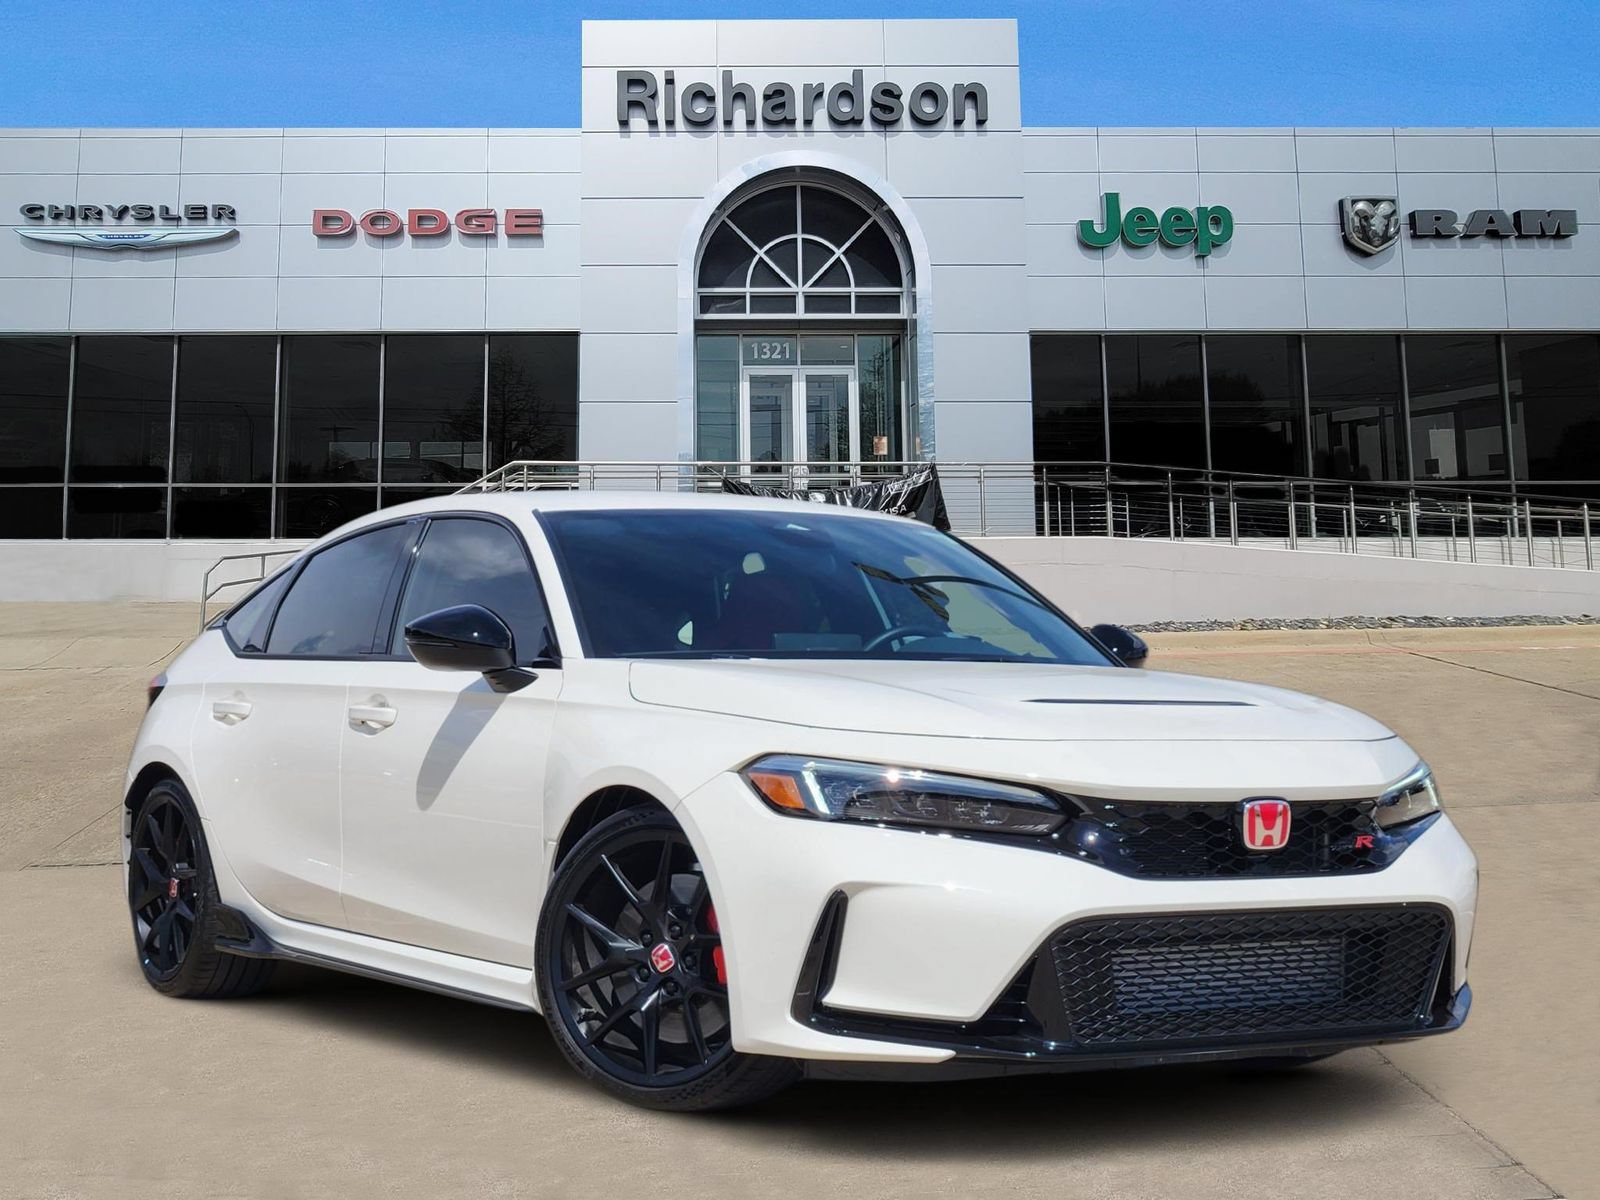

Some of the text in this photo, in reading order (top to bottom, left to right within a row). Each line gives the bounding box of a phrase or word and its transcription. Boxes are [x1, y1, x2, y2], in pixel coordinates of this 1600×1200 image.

[616, 69, 989, 127] Richardson
[19, 203, 237, 220] CHRYSLER
[312, 208, 545, 238] DODGE
[1077, 192, 1234, 257] Jeep
[1408, 209, 1578, 238] RAM
[751, 342, 790, 359] 1321
[1355, 835, 1374, 849] R
